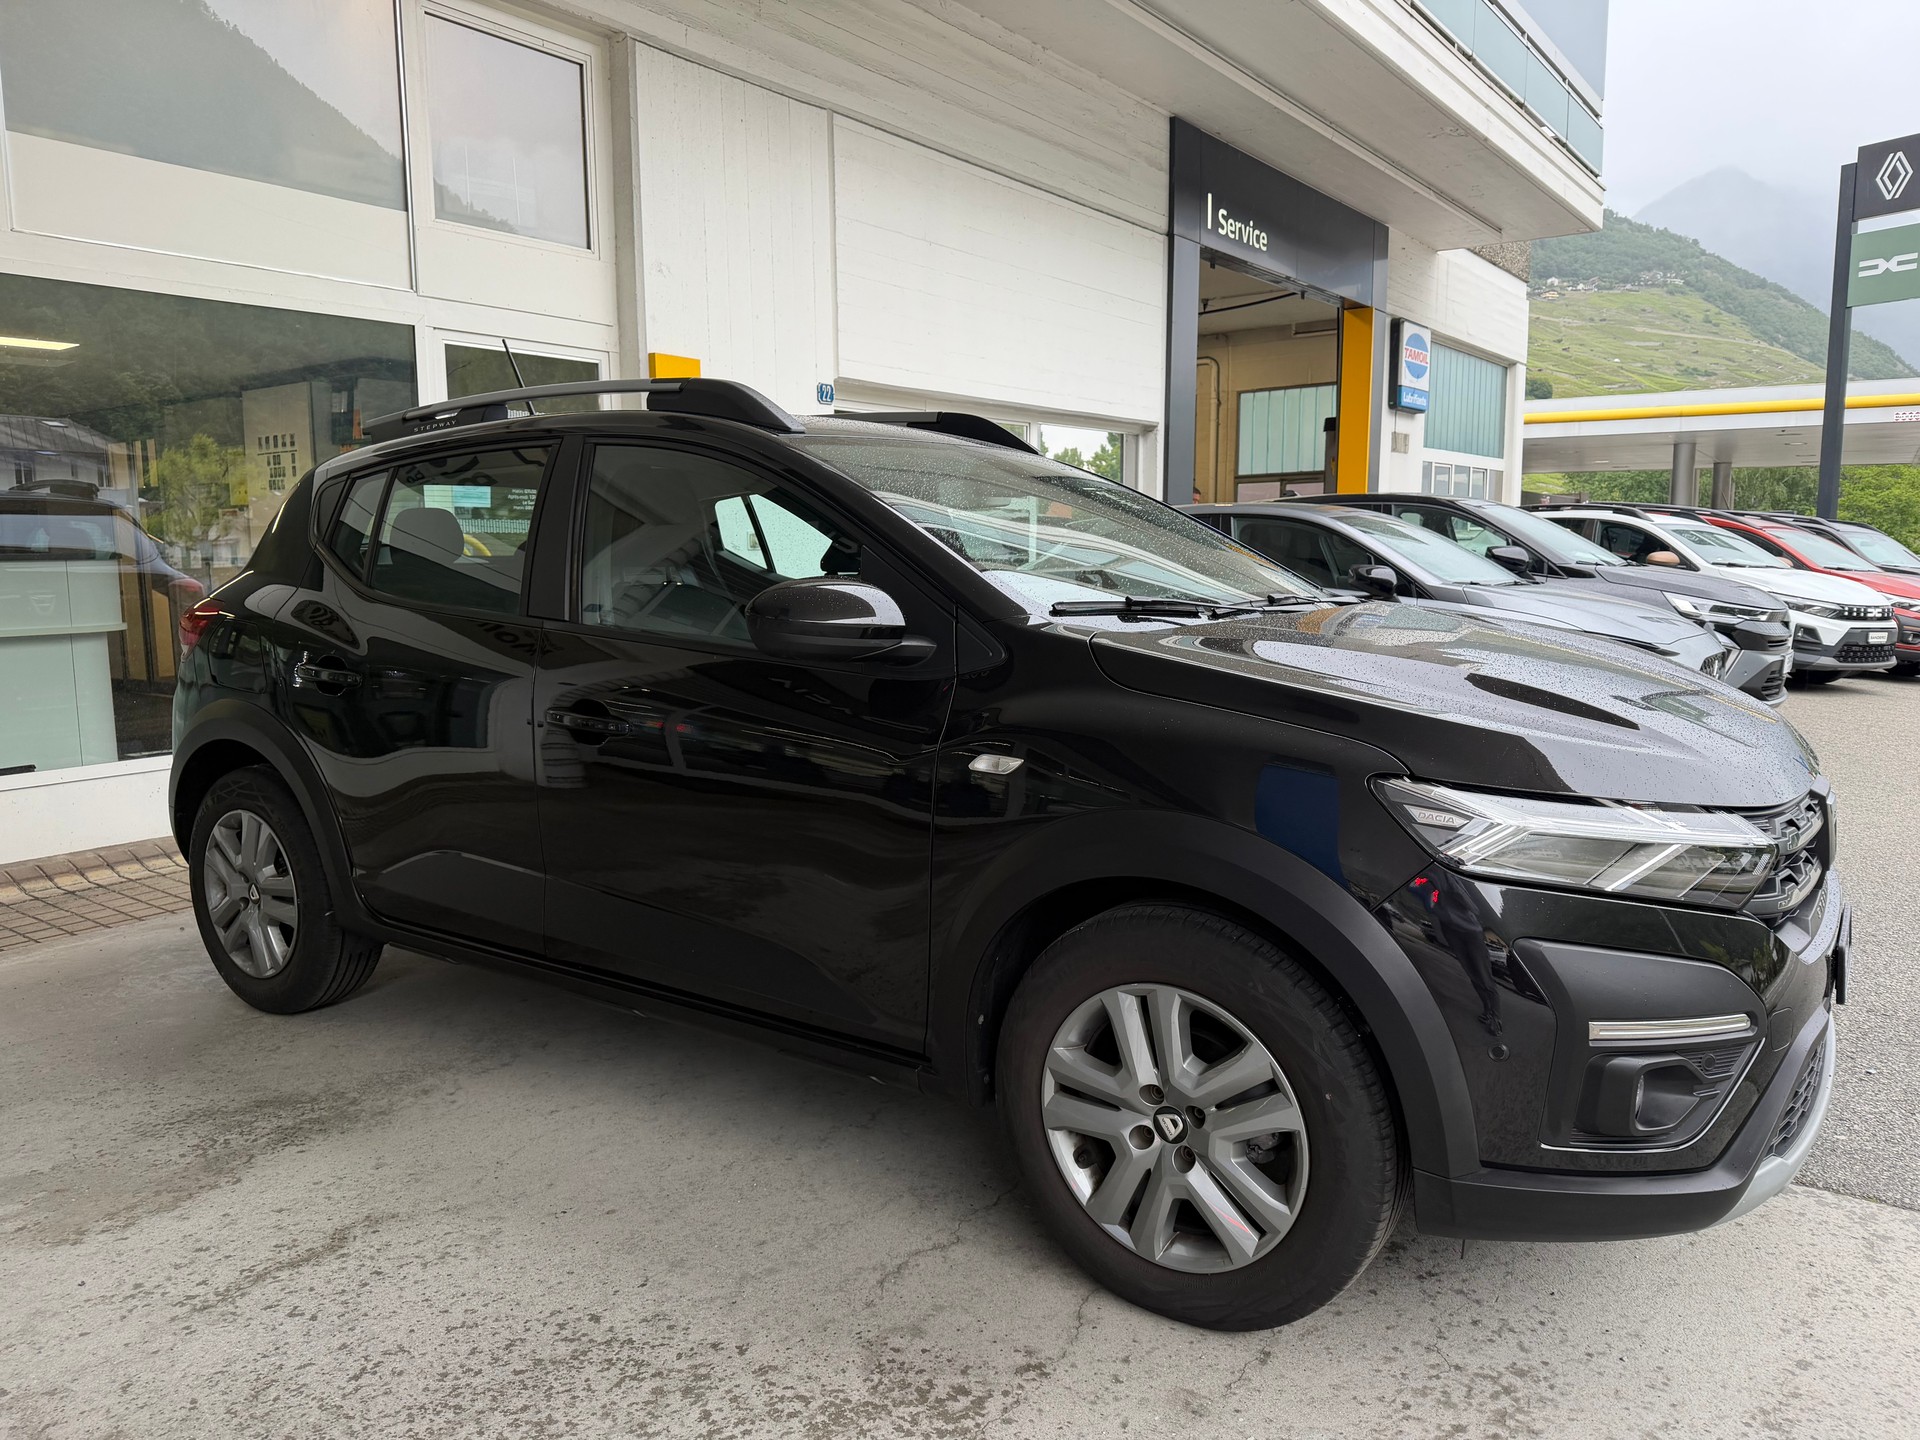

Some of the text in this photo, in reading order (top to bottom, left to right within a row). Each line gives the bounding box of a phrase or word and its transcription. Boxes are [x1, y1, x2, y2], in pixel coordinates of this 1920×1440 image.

[1218, 208, 1268, 252] Service
[1404, 347, 1429, 365] TAMOIL
[822, 384, 832, 402] 22
[413, 420, 457, 433] STEPWAY
[1417, 811, 1455, 824] DACIA
